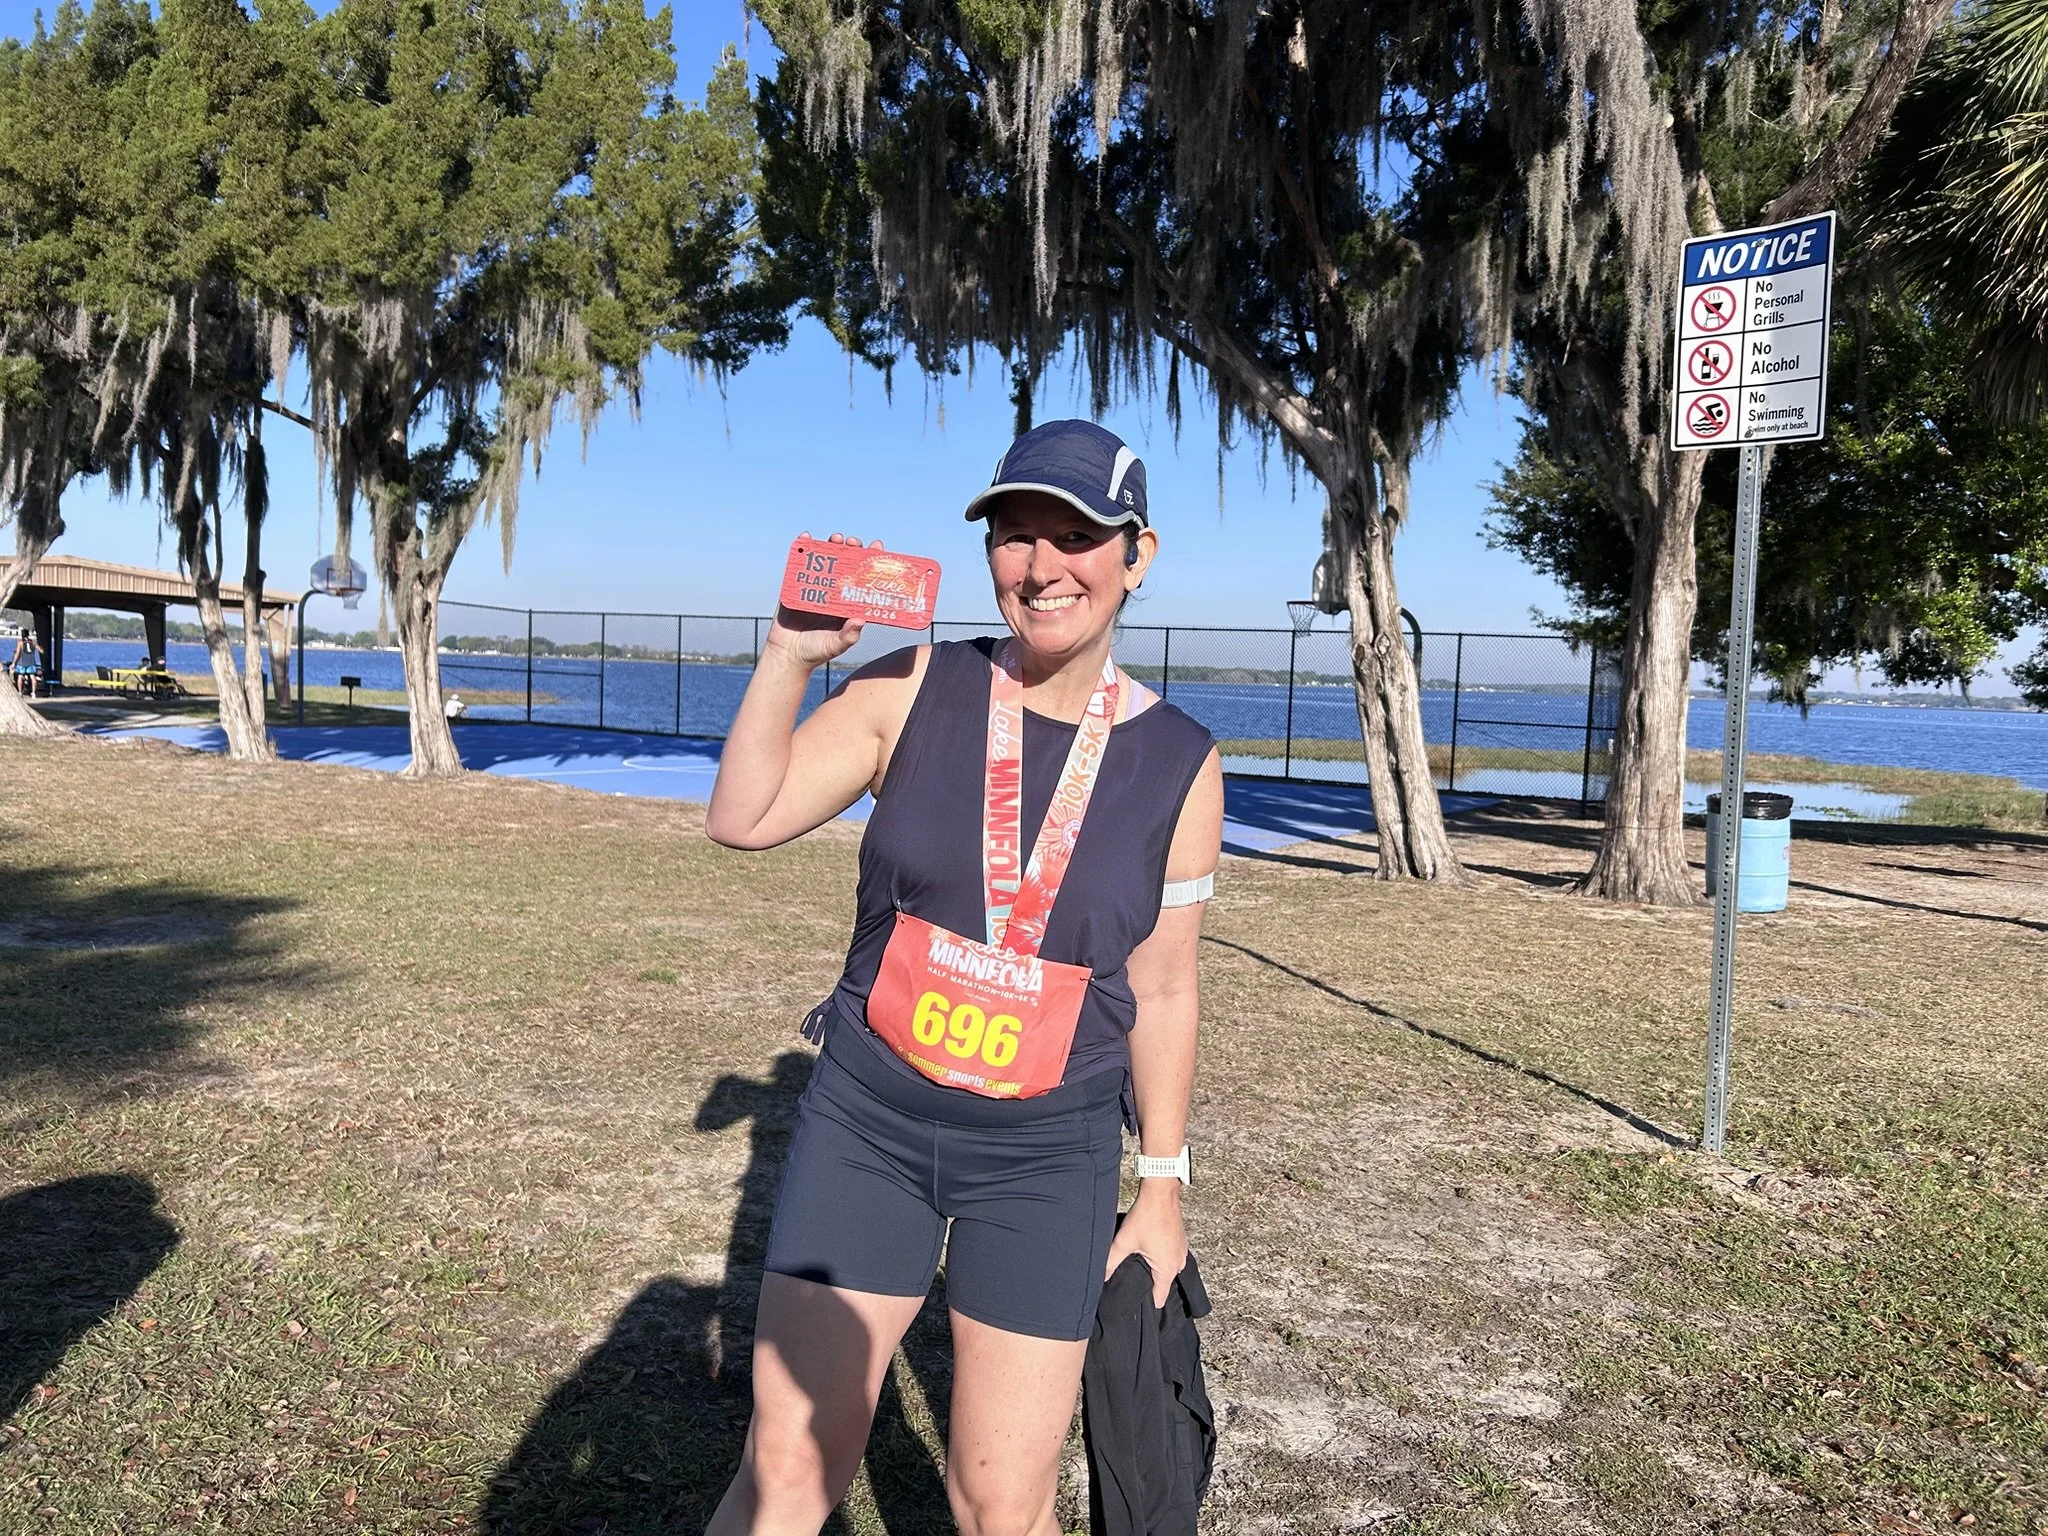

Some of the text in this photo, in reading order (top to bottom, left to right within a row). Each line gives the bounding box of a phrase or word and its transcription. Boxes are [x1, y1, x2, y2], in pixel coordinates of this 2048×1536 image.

[1697, 228, 1817, 279] NOTICE
[1755, 280, 1773, 293] No
[1755, 290, 1804, 309] Personal
[1753, 313, 1785, 326] Grills
[1752, 342, 1771, 356] No
[1750, 355, 1799, 375] Alcohol
[1749, 391, 1765, 404] No
[1748, 405, 1804, 421] Swimming
[1767, 424, 1780, 433] only
[1789, 420, 1808, 430] beach
[805, 551, 838, 574] 1ST
[796, 571, 837, 588] PLACE
[866, 570, 907, 594] Lake
[800, 587, 829, 605] 10K
[865, 607, 897, 620] 2026
[989, 699, 1022, 763] Lake
[987, 759, 1020, 907] MINNEOLA
[927, 965, 948, 978] HALF
[912, 991, 1023, 1068] 696
